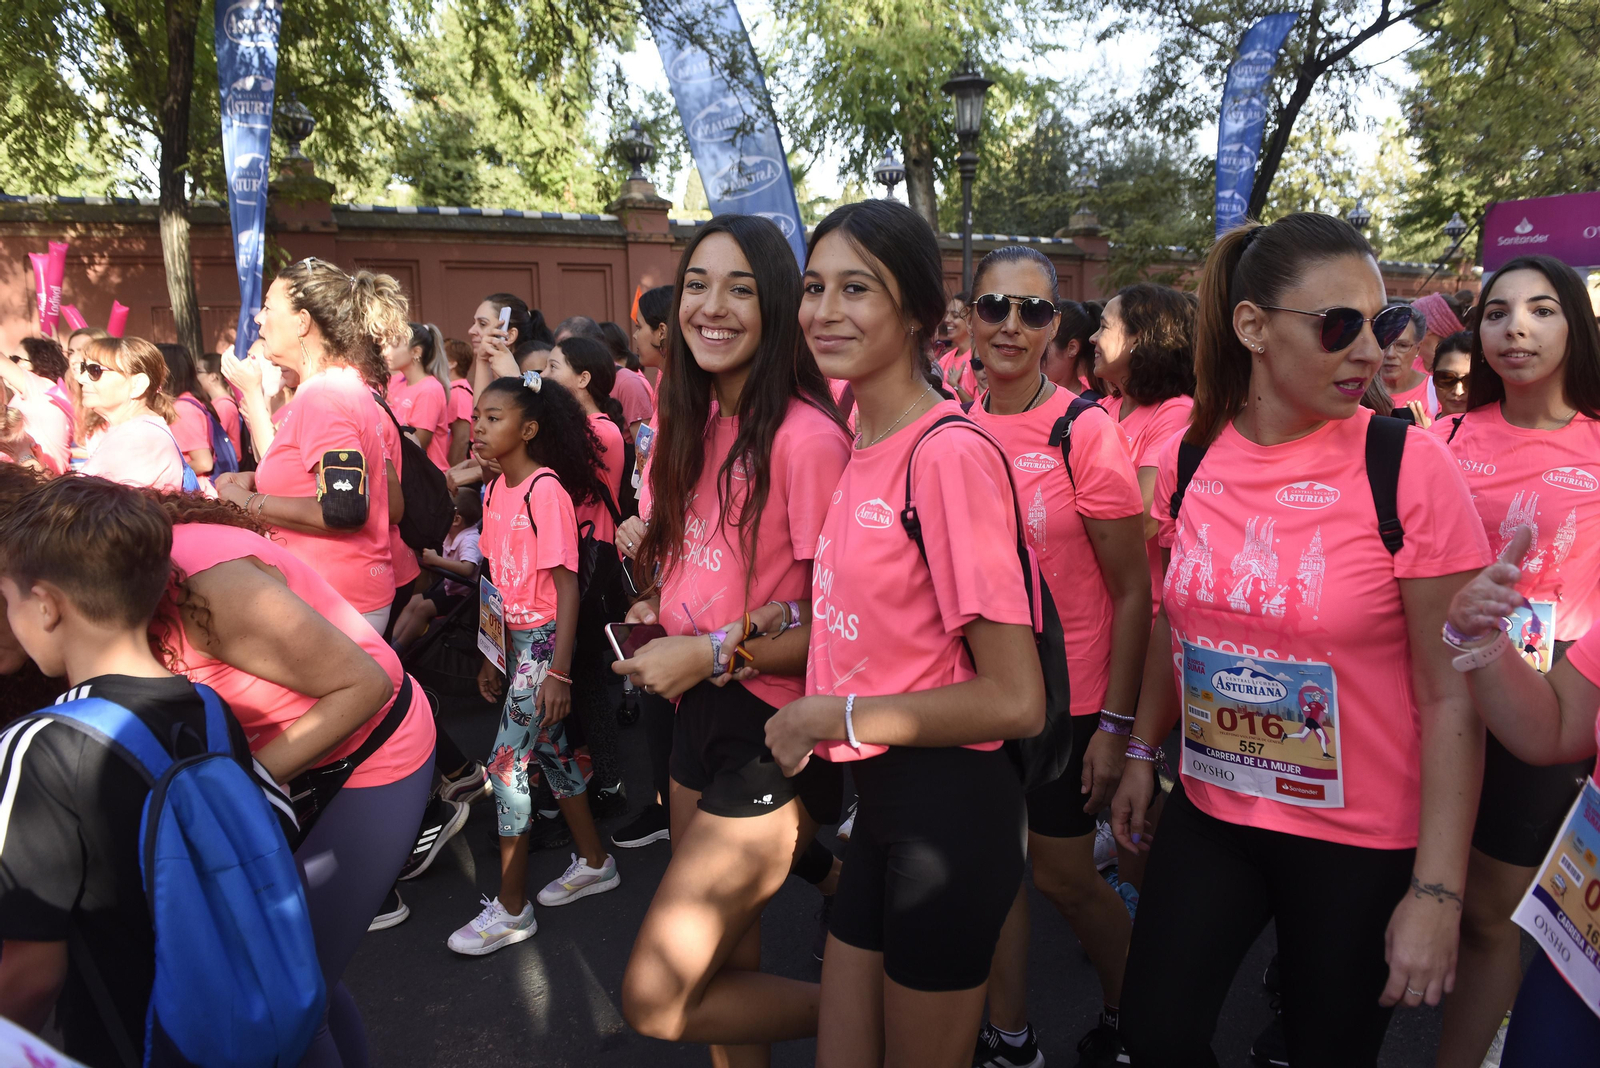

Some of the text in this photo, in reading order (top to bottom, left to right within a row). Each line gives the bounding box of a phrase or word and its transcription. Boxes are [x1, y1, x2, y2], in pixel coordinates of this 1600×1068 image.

[1497, 233, 1550, 246] Santander
[1017, 458, 1055, 469] ASTURIANA
[1458, 459, 1497, 476] YSHO
[1188, 480, 1224, 495] YSHO
[1545, 472, 1594, 490] ASTURIANA
[1280, 490, 1336, 504] ASTURIANA
[813, 595, 859, 641] CCAS
[1187, 662, 1206, 675] SUMA
[1216, 675, 1283, 697] ASTURIANA
[1225, 676, 1250, 684] CENTRAL
[1216, 707, 1284, 739] 016
[1239, 740, 1264, 755] 557
[1206, 747, 1301, 775] CARRERA DE LA MUJER
[1192, 759, 1235, 782] OYSHO
[1289, 784, 1318, 796] Santander
[1556, 909, 1585, 950] CARRERA
[1534, 914, 1571, 963] OYSHO
